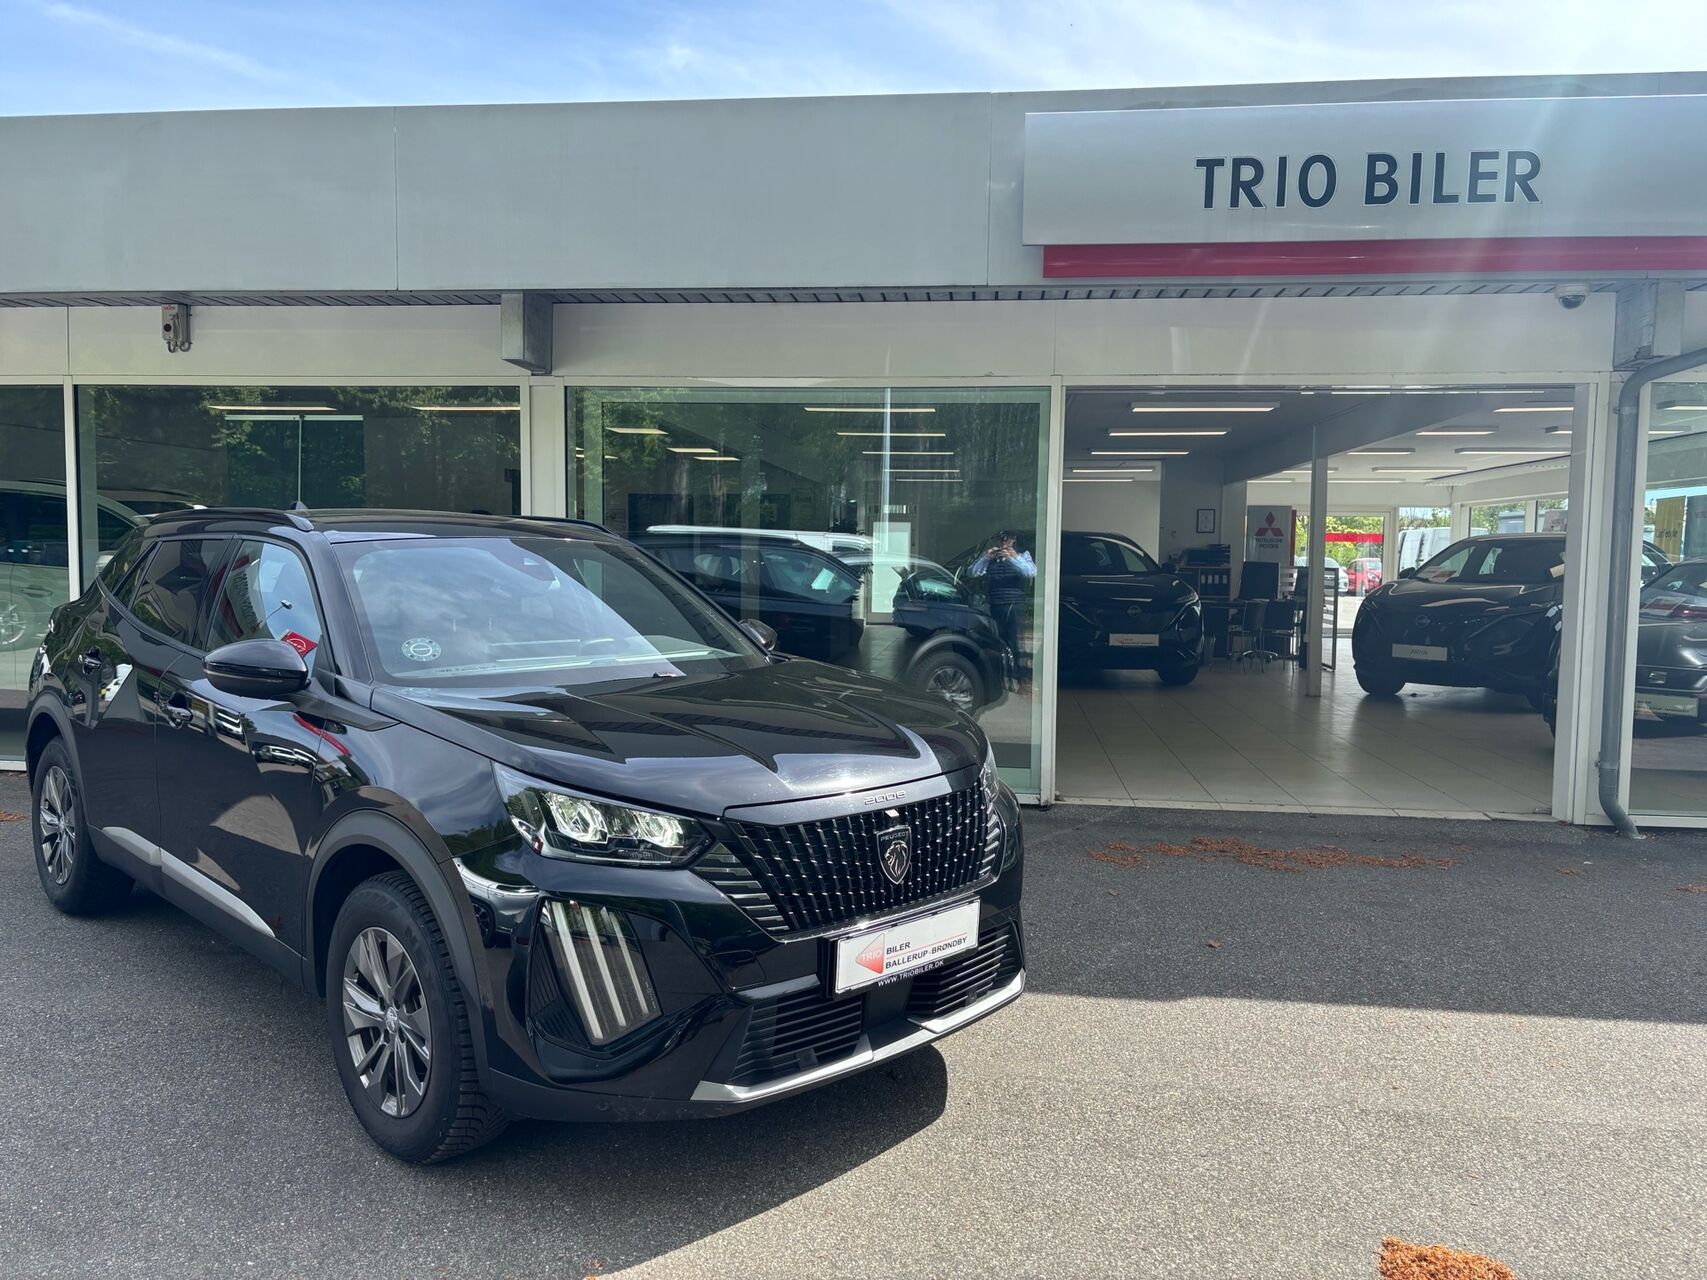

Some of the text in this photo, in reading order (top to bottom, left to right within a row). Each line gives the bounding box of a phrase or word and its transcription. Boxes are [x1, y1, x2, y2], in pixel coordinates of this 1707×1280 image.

[1195, 149, 1543, 209] TRIO BILER
[864, 791, 906, 806] 2008
[861, 950, 883, 962] TRIO
[885, 936, 968, 969] BALLERUP BRØNDBY
[886, 941, 911, 955] BILER
[877, 960, 945, 987] WWW.TRIOBILER.DK
